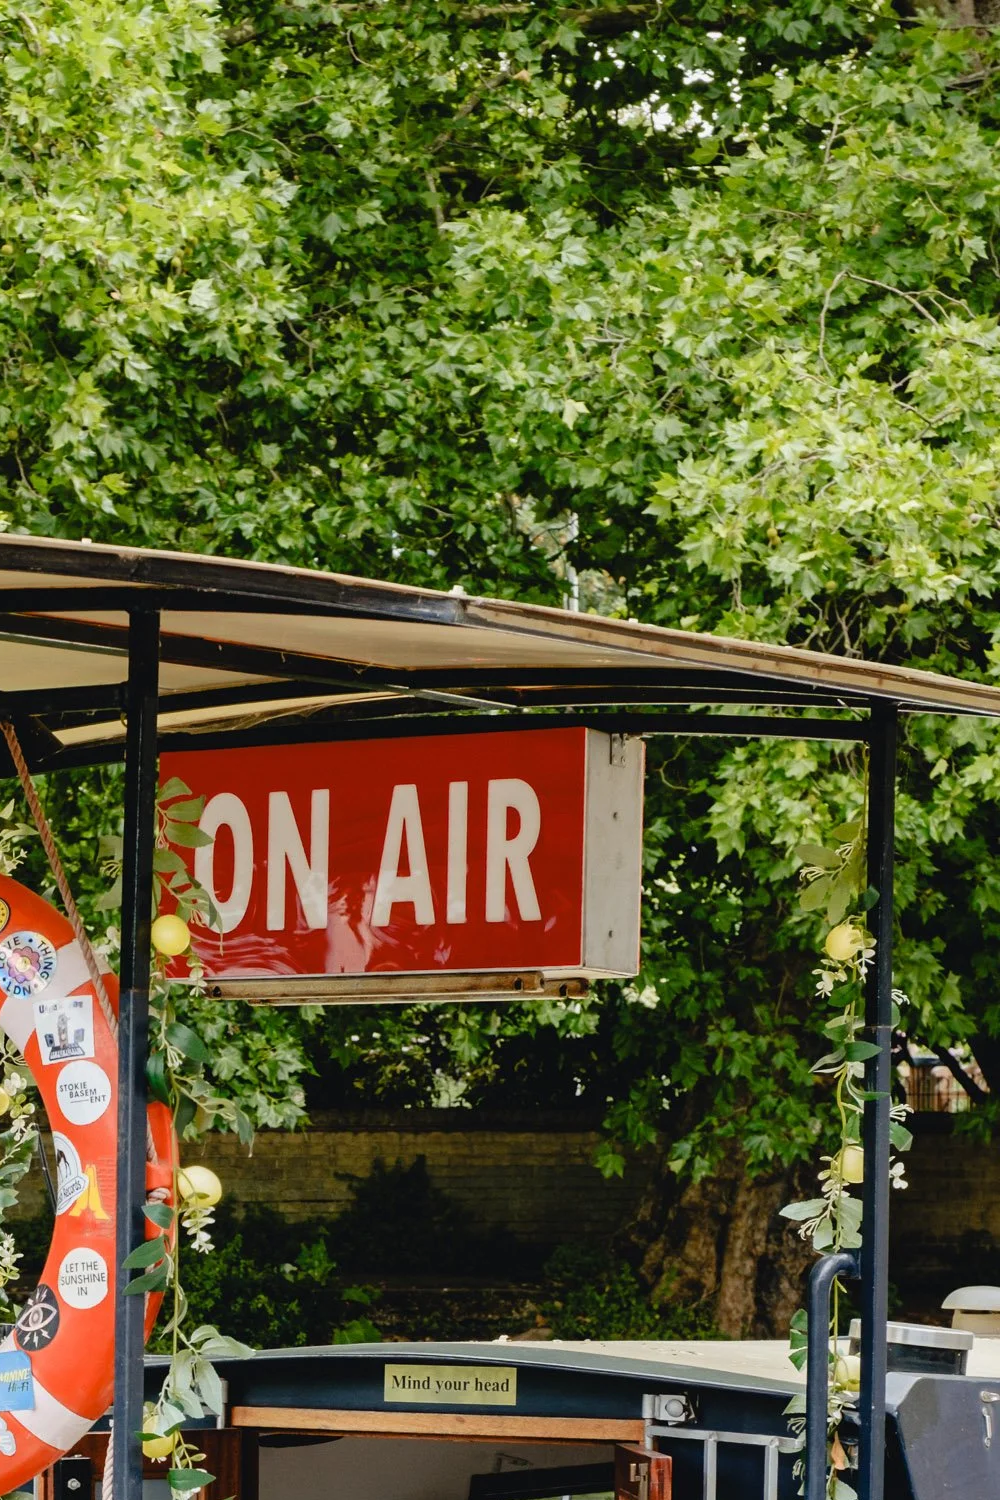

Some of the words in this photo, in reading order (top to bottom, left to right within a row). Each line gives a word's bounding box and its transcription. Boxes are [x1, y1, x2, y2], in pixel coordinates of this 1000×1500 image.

[195, 788, 330, 934] ON
[371, 778, 542, 927] AIR
[37, 940, 53, 980] THING
[6, 981, 32, 996] LDN
[60, 1081, 87, 1092] STOKIE
[69, 1088, 97, 1099] BASEM
[90, 1094, 107, 1103] ENT
[65, 1262, 79, 1273] LET
[81, 1260, 99, 1271] THE
[60, 1272, 106, 1286] SUNSHINE
[77, 1286, 88, 1296] IN
[391, 1375, 431, 1390] Mind
[435, 1379, 470, 1394] your
[475, 1377, 510, 1392] head
